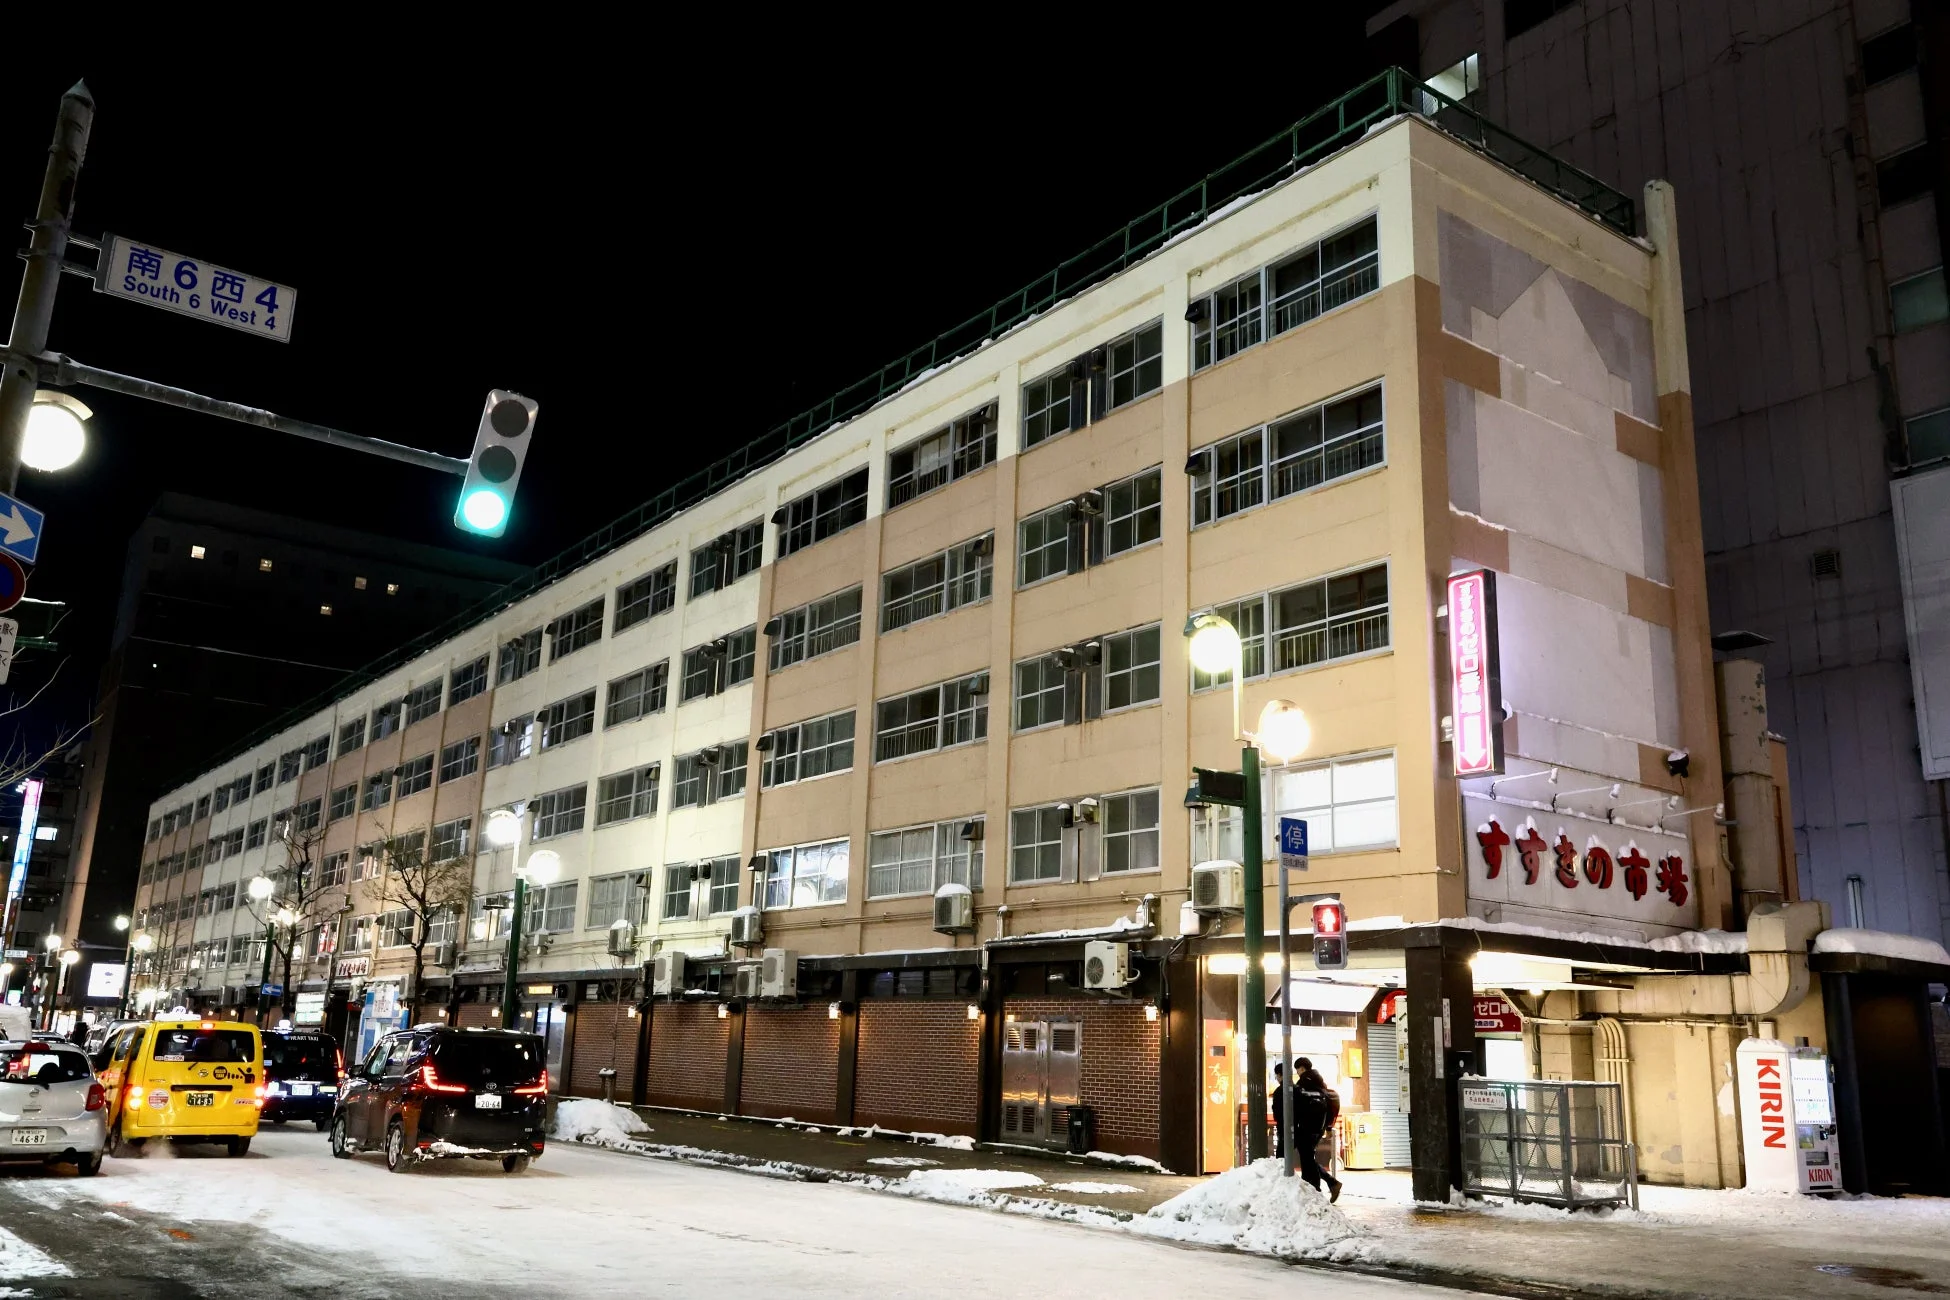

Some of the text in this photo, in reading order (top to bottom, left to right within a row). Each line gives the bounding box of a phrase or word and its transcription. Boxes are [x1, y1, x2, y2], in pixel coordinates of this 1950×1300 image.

[123, 275, 276, 330] South 6 West 4
[1285, 825, 1304, 849] 停
[1477, 818, 1689, 907] すすきの市場
[1756, 1058, 1786, 1149] KIRIN
[19, 1134, 45, 1144] 46-87
[1808, 1168, 1833, 1182] KIRIN
